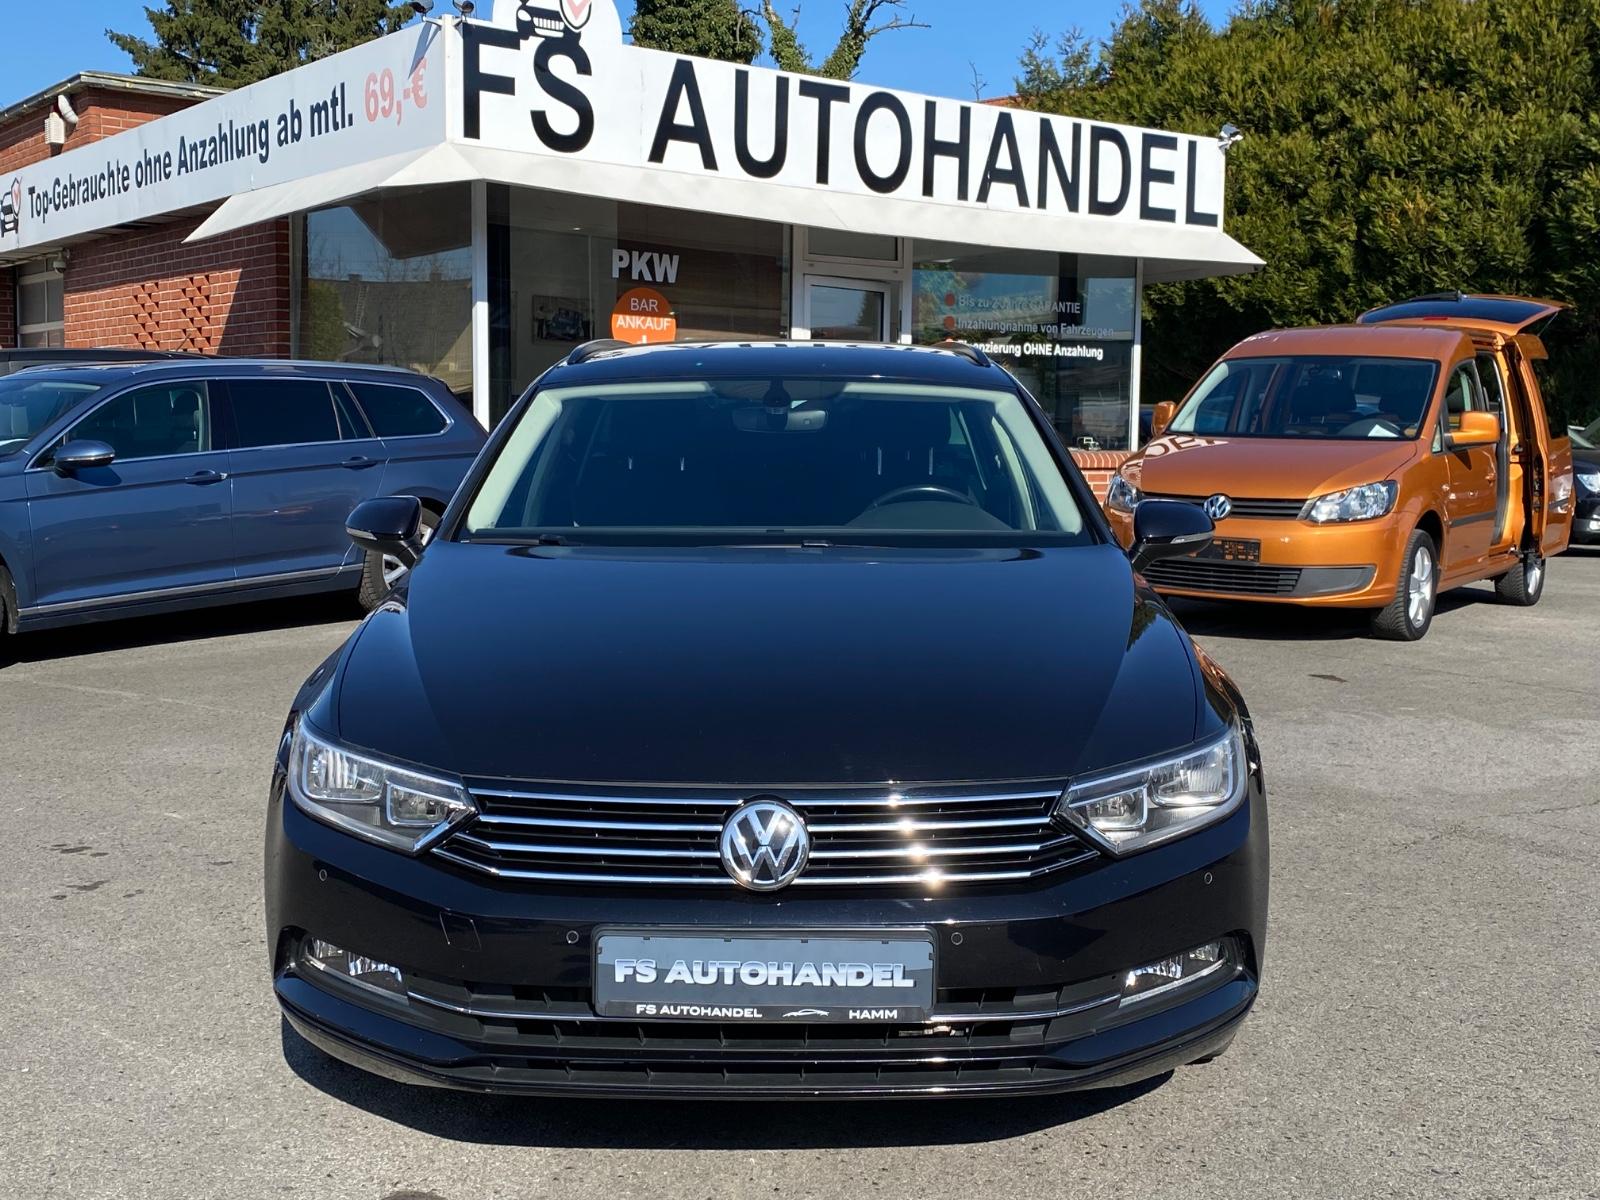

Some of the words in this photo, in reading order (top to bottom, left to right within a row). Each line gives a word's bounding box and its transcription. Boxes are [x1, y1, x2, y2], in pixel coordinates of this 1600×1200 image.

[462, 22, 594, 153] FS
[647, 58, 1219, 227] AUTOHANDEL
[27, 160, 130, 224] Top-Gebrauchte
[135, 148, 172, 188] ohne
[177, 119, 270, 176] Anzahlung
[276, 99, 302, 147] ab
[309, 82, 354, 138] mtl.
[364, 57, 428, 127] 69,-€
[612, 248, 680, 283] PKW
[630, 297, 659, 312] BAR
[958, 295, 975, 307] Bis
[977, 298, 989, 308] zu
[1029, 299, 1081, 314] GARANTIE
[615, 315, 672, 331] ANKAUF
[957, 318, 1038, 333] Inzahlungnahme
[1040, 325, 1058, 334] von
[1060, 323, 1114, 339] Fahrzeugen
[1023, 342, 1052, 355] OHNE
[1053, 343, 1104, 360] Anzahlung
[614, 959, 657, 983] FS
[664, 960, 915, 988] AUTOHANDEL
[636, 1004, 656, 1015] FS
[660, 1005, 762, 1018] AUTOHANDEL
[848, 1009, 898, 1020] HAMM
